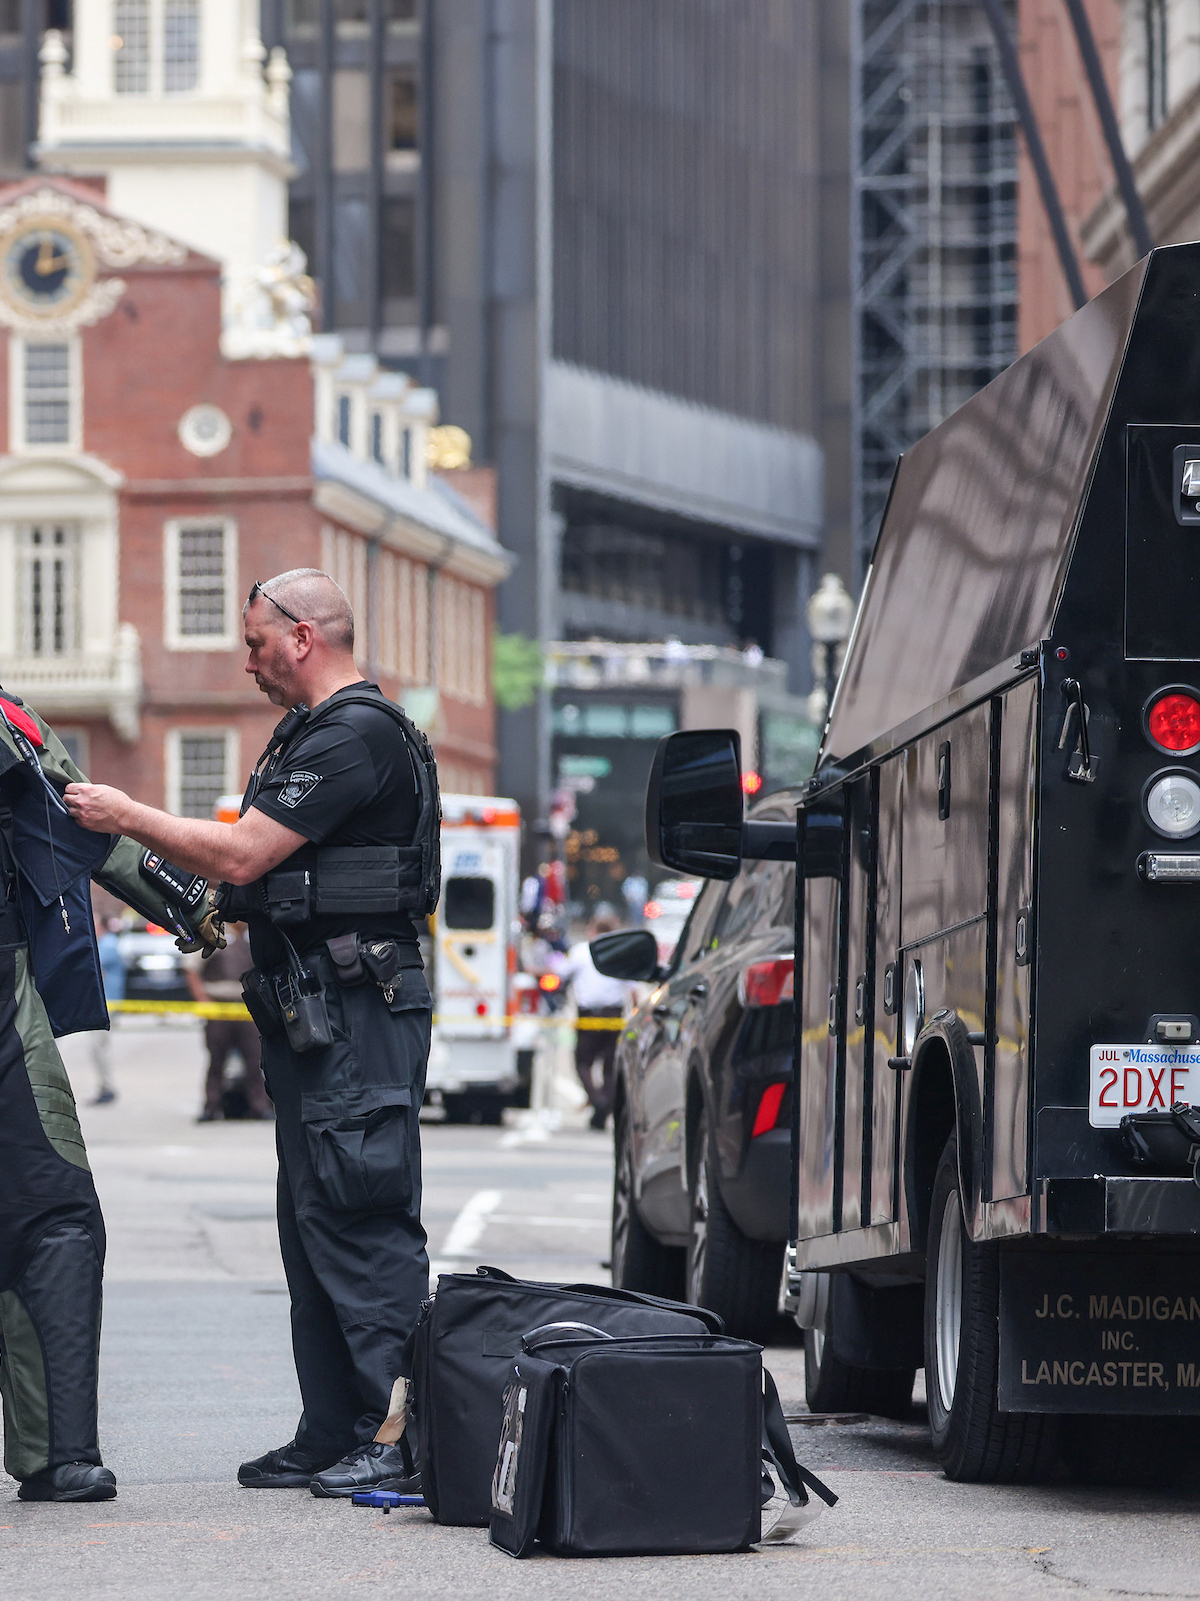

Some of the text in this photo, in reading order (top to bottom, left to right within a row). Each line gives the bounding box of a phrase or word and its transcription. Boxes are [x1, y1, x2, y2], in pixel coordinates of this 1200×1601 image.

[1099, 1050, 1120, 1061] JUL
[1099, 1067, 1189, 1107] 2DXE
[1035, 1293, 1200, 1321] J.C. MADIGAN
[1101, 1331, 1140, 1351] INC.
[1021, 1360, 1200, 1391] LANCASTER, M
